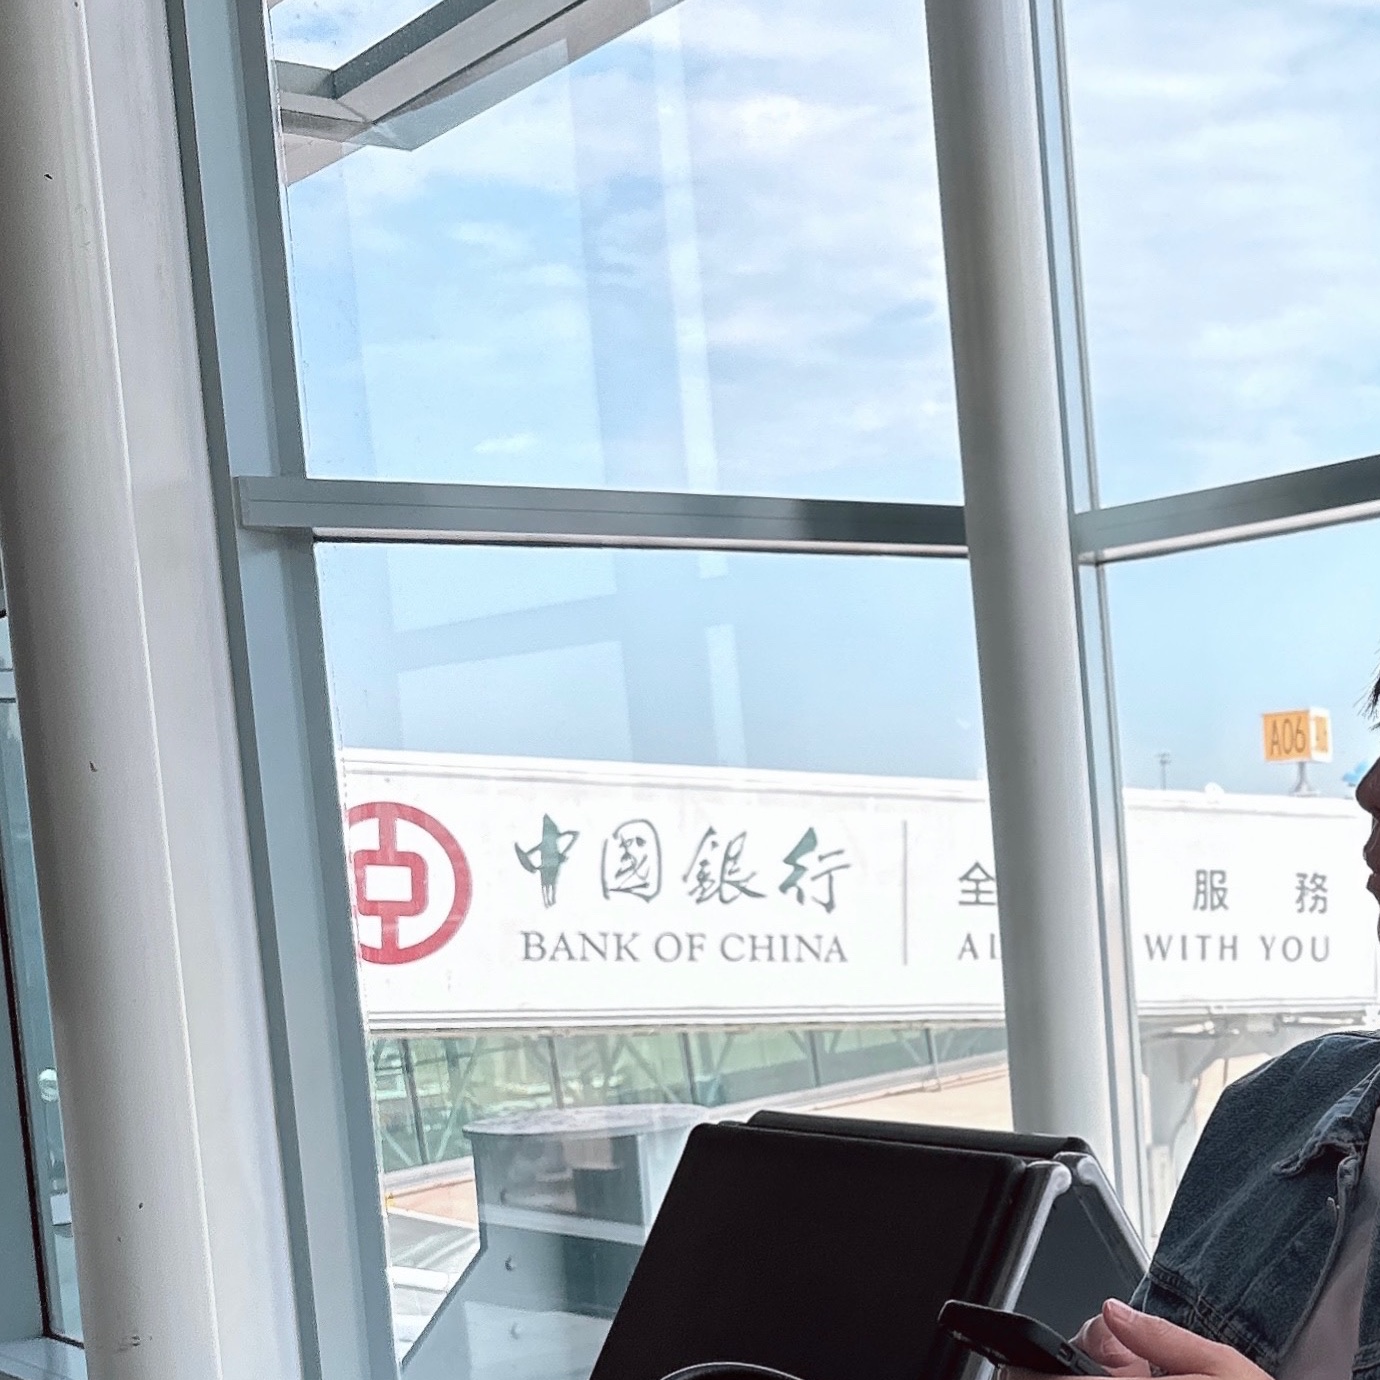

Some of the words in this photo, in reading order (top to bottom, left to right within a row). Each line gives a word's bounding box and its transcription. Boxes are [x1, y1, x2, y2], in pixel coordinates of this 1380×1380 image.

[1270, 716, 1306, 756] A06
[514, 813, 851, 914] 中國銀行
[521, 931, 639, 962] BANK
[654, 932, 705, 962] OF
[720, 934, 848, 963] CHINA
[1144, 934, 1238, 961] WITH
[1260, 936, 1329, 962] YOU
